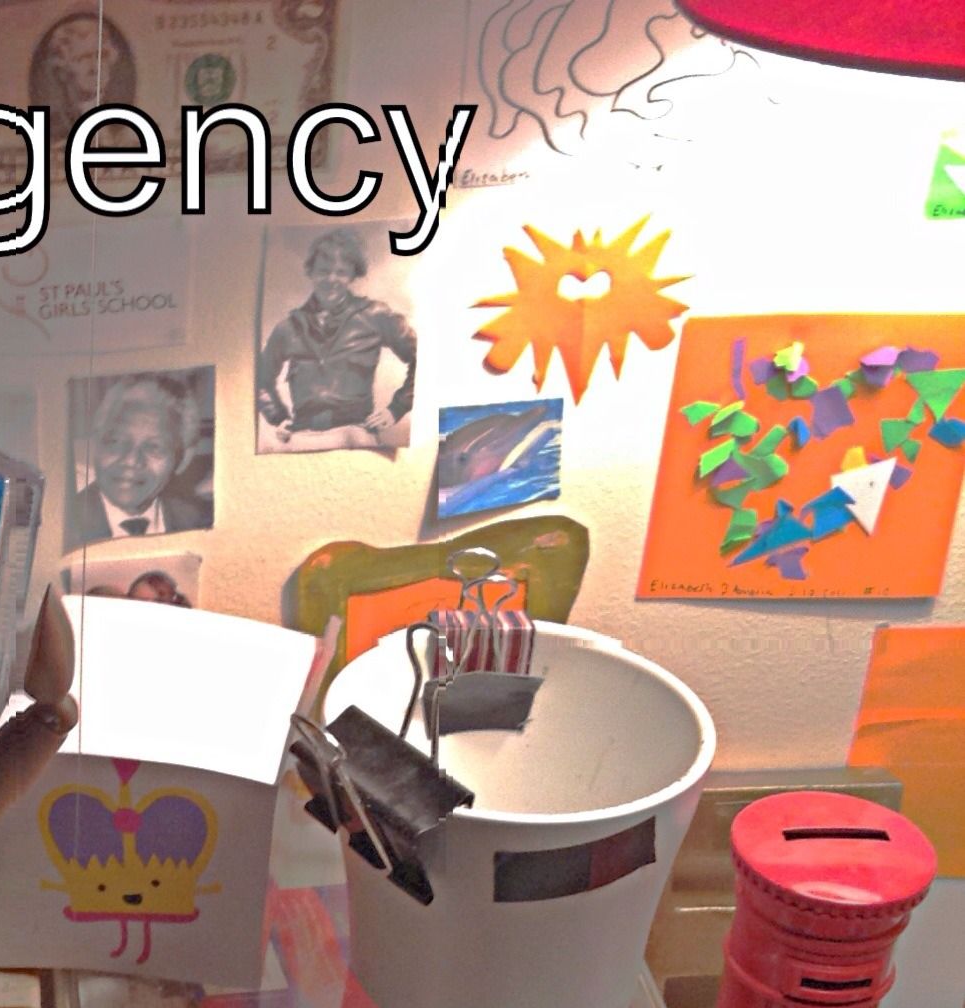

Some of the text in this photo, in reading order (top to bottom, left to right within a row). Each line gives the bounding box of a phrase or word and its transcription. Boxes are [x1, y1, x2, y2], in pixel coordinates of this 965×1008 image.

[39, 279, 125, 303] ST PAUL'S
[38, 292, 178, 321] GIRLS SCHOOL
